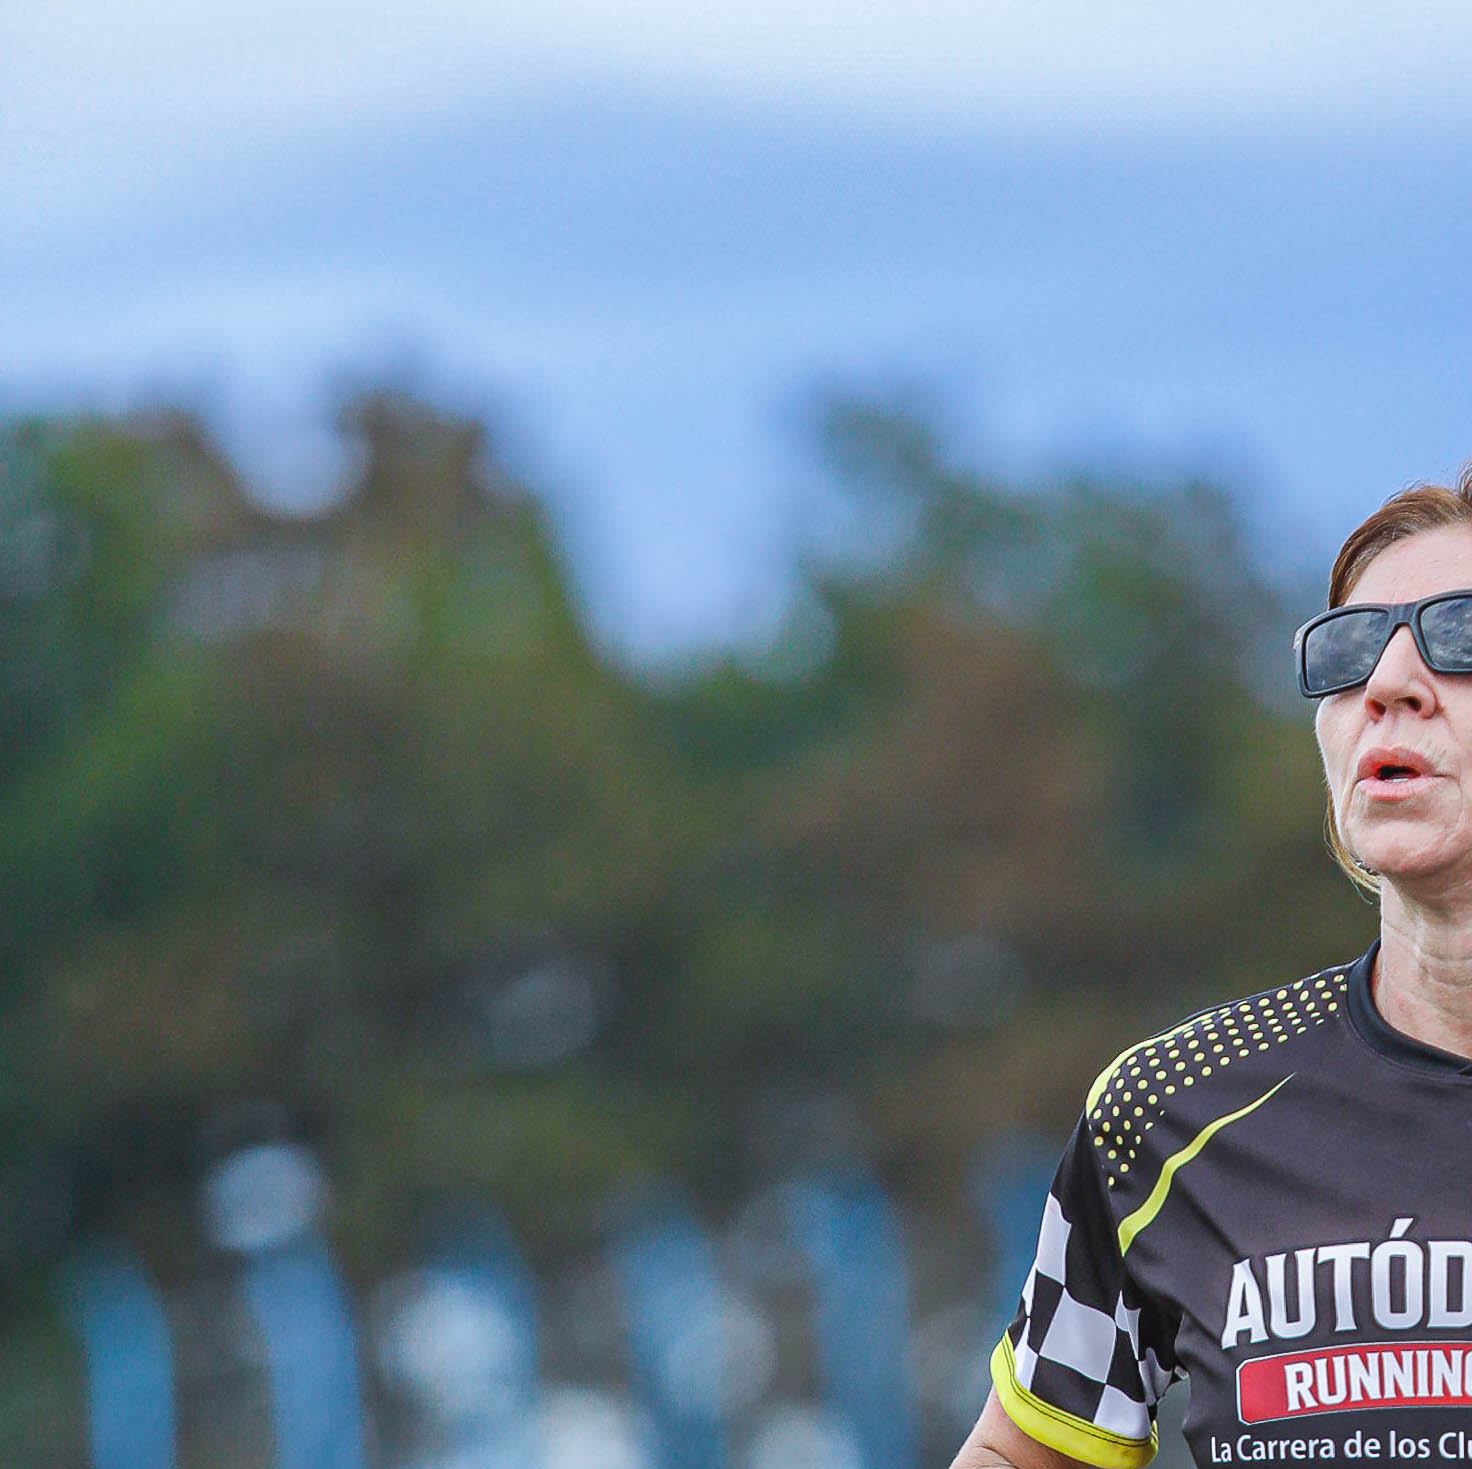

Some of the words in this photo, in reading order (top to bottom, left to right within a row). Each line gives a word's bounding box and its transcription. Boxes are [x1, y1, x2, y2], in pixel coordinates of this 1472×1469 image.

[1211, 1437, 1232, 1463] La
[1236, 1434, 1336, 1461] Carrera
[1343, 1430, 1381, 1459] de
[1389, 1430, 1430, 1459] los
